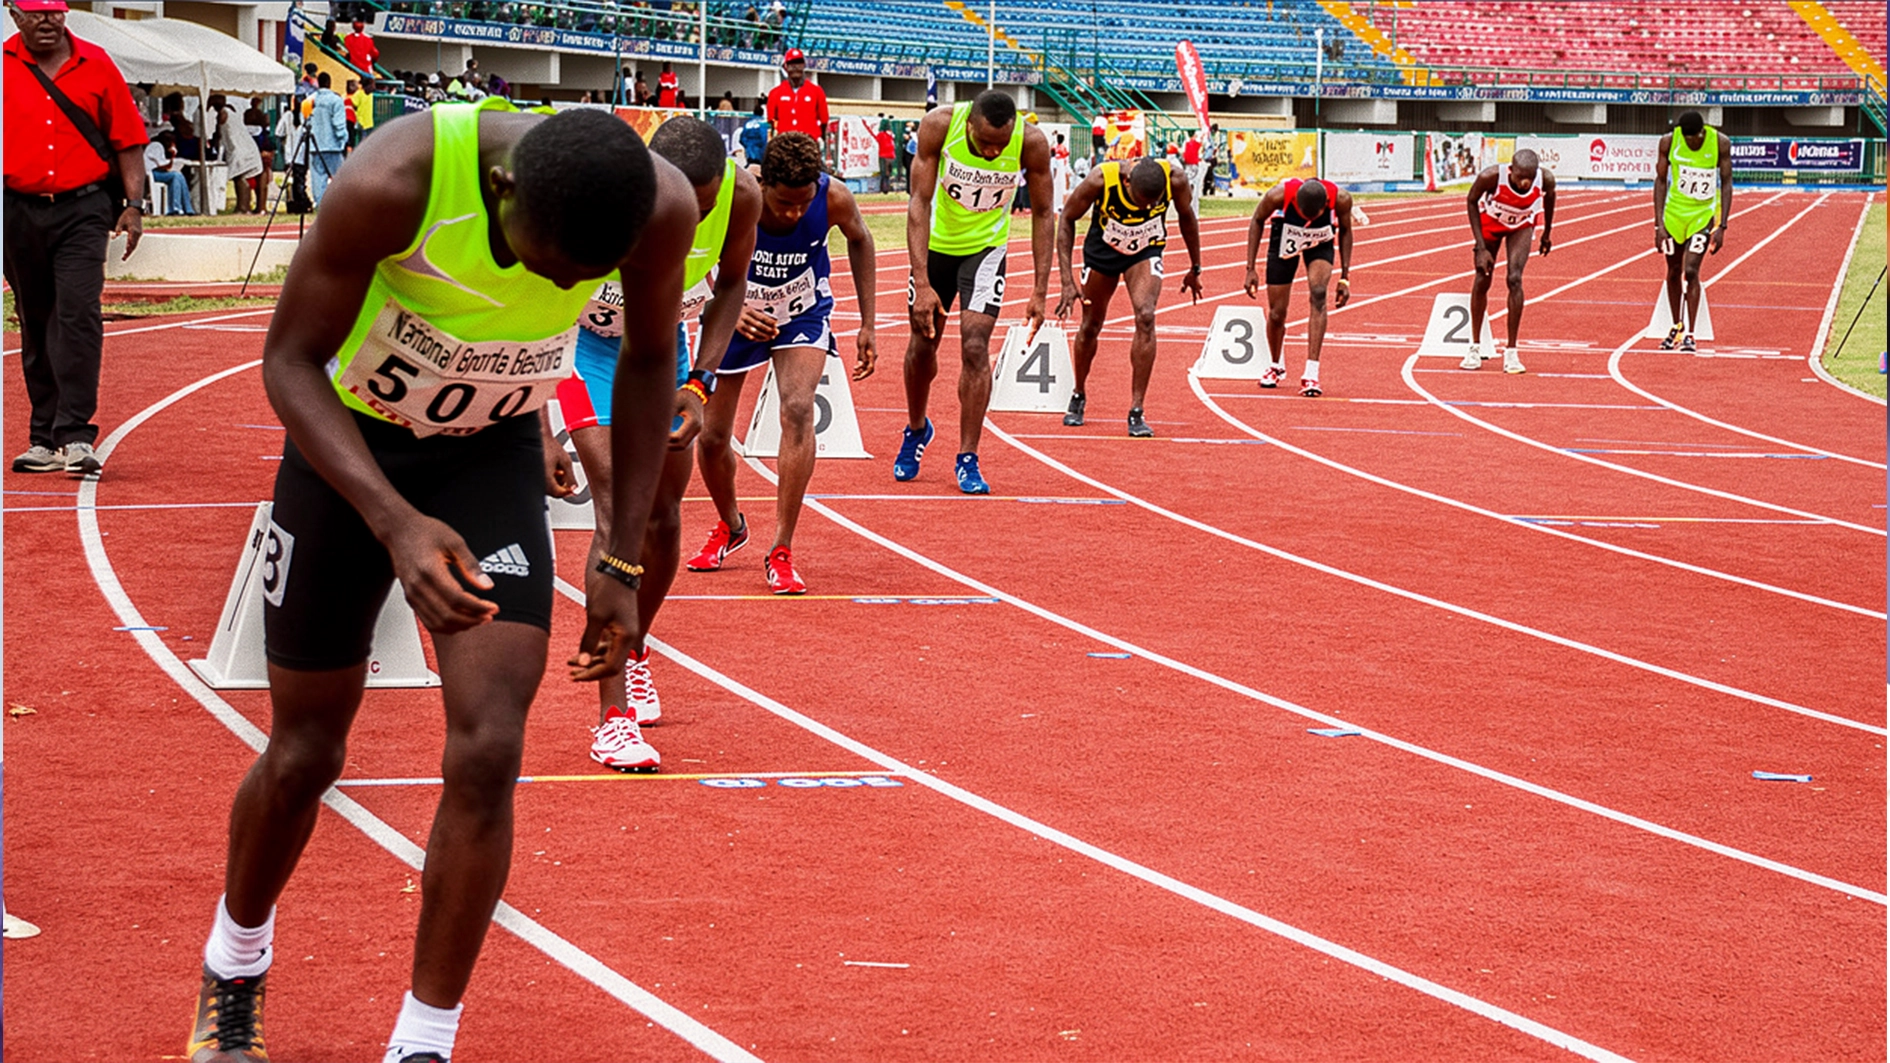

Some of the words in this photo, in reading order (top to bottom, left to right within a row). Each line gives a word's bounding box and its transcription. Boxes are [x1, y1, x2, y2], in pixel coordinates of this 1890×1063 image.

[1222, 319, 1254, 365] 3
[1443, 305, 1470, 344] 2
[367, 354, 534, 424] 500
[1016, 343, 1056, 394] 4
